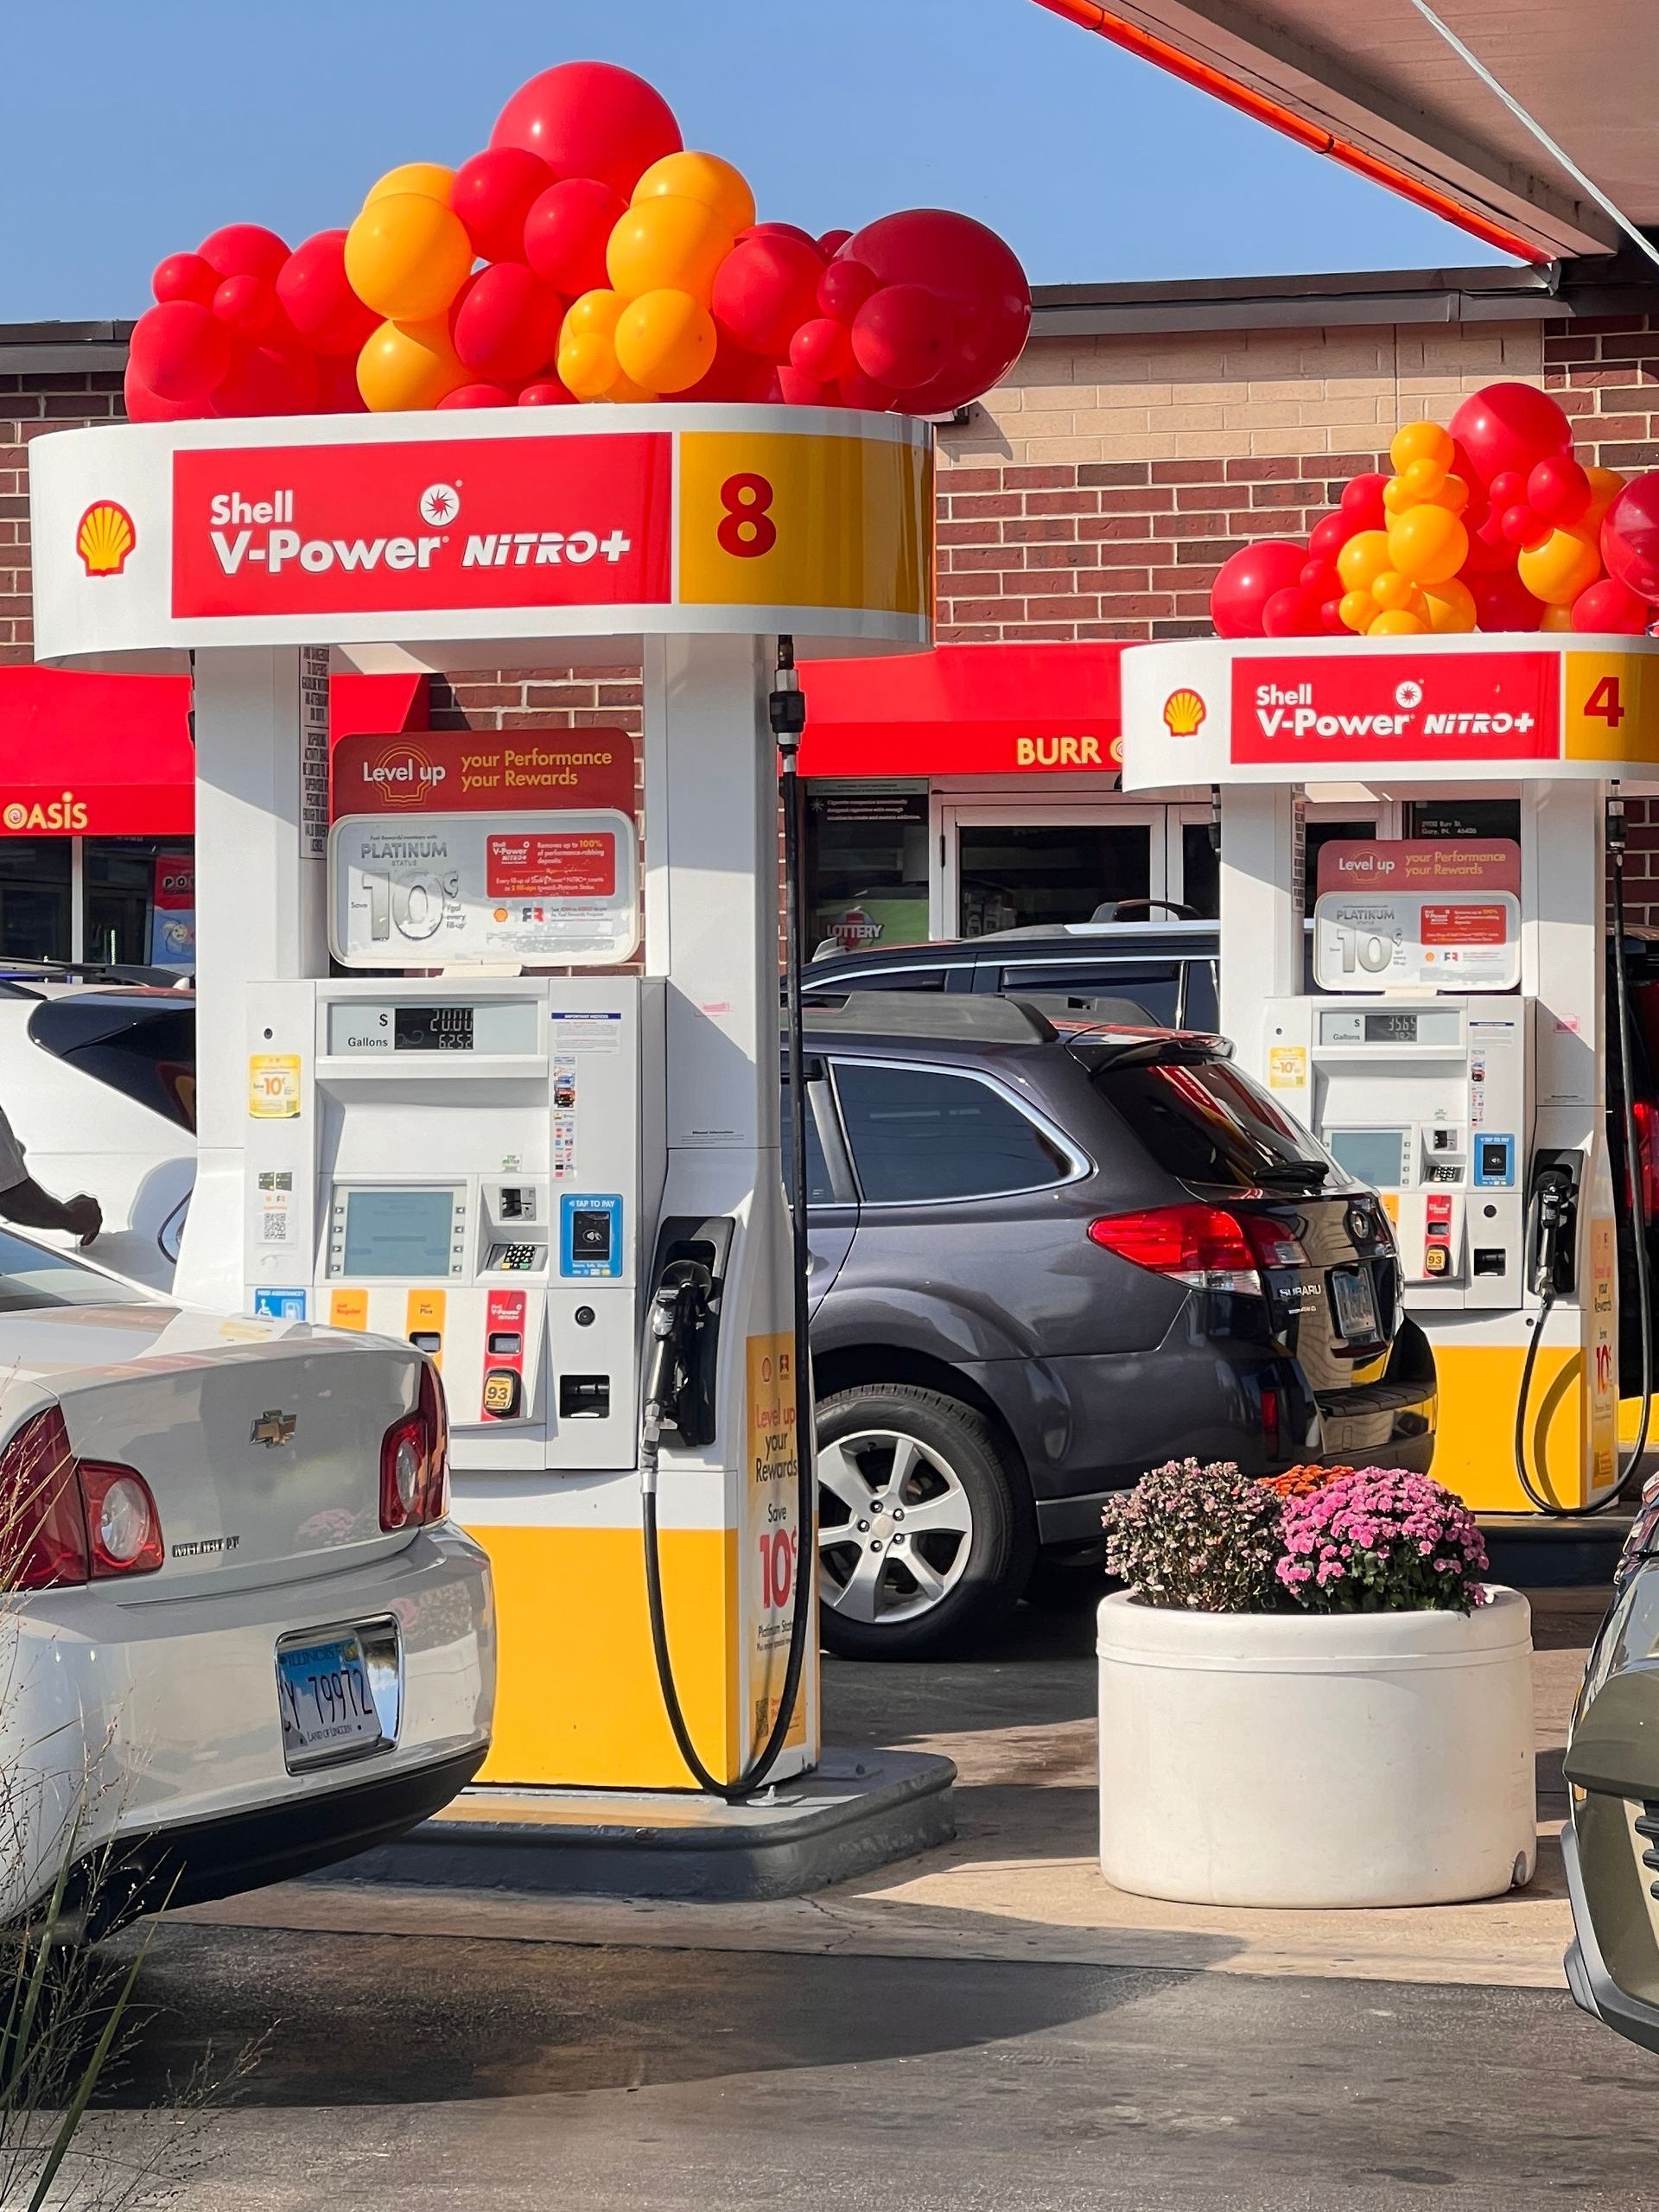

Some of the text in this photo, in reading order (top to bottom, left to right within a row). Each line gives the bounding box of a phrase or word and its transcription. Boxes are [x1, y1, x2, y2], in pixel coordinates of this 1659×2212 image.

[210, 489, 294, 526] Shell
[717, 473, 777, 558] 8
[210, 530, 442, 575] V-Power
[1256, 683, 1312, 706] Shell
[1583, 677, 1625, 728] 4
[1256, 709, 1410, 738] V-Power
[461, 747, 613, 773] your Performance
[1017, 735, 1103, 766] BURR
[363, 759, 446, 787] Level up
[461, 766, 579, 792] your Rewards
[360, 842, 448, 859] PLATINUM
[493, 847, 528, 855] V-Power
[579, 839, 603, 848] 100%
[1338, 856, 1395, 874] Level up
[1405, 850, 1507, 865] your Performance
[1405, 863, 1484, 878] your Rewards
[1336, 909, 1395, 920] PLATINUM
[826, 924, 883, 938] LOTTERY
[347, 1037, 388, 1047] Gallons
[1427, 1255, 1442, 1264] 93
[1279, 1284, 1322, 1297] SUBARU
[486, 1386, 508, 1400] 93
[756, 1397, 796, 1432] Level up
[765, 1432, 788, 1461] your
[755, 1448, 798, 1483] Rewards
[767, 1503, 787, 1523] Save
[308, 1669, 373, 1725] 79972
